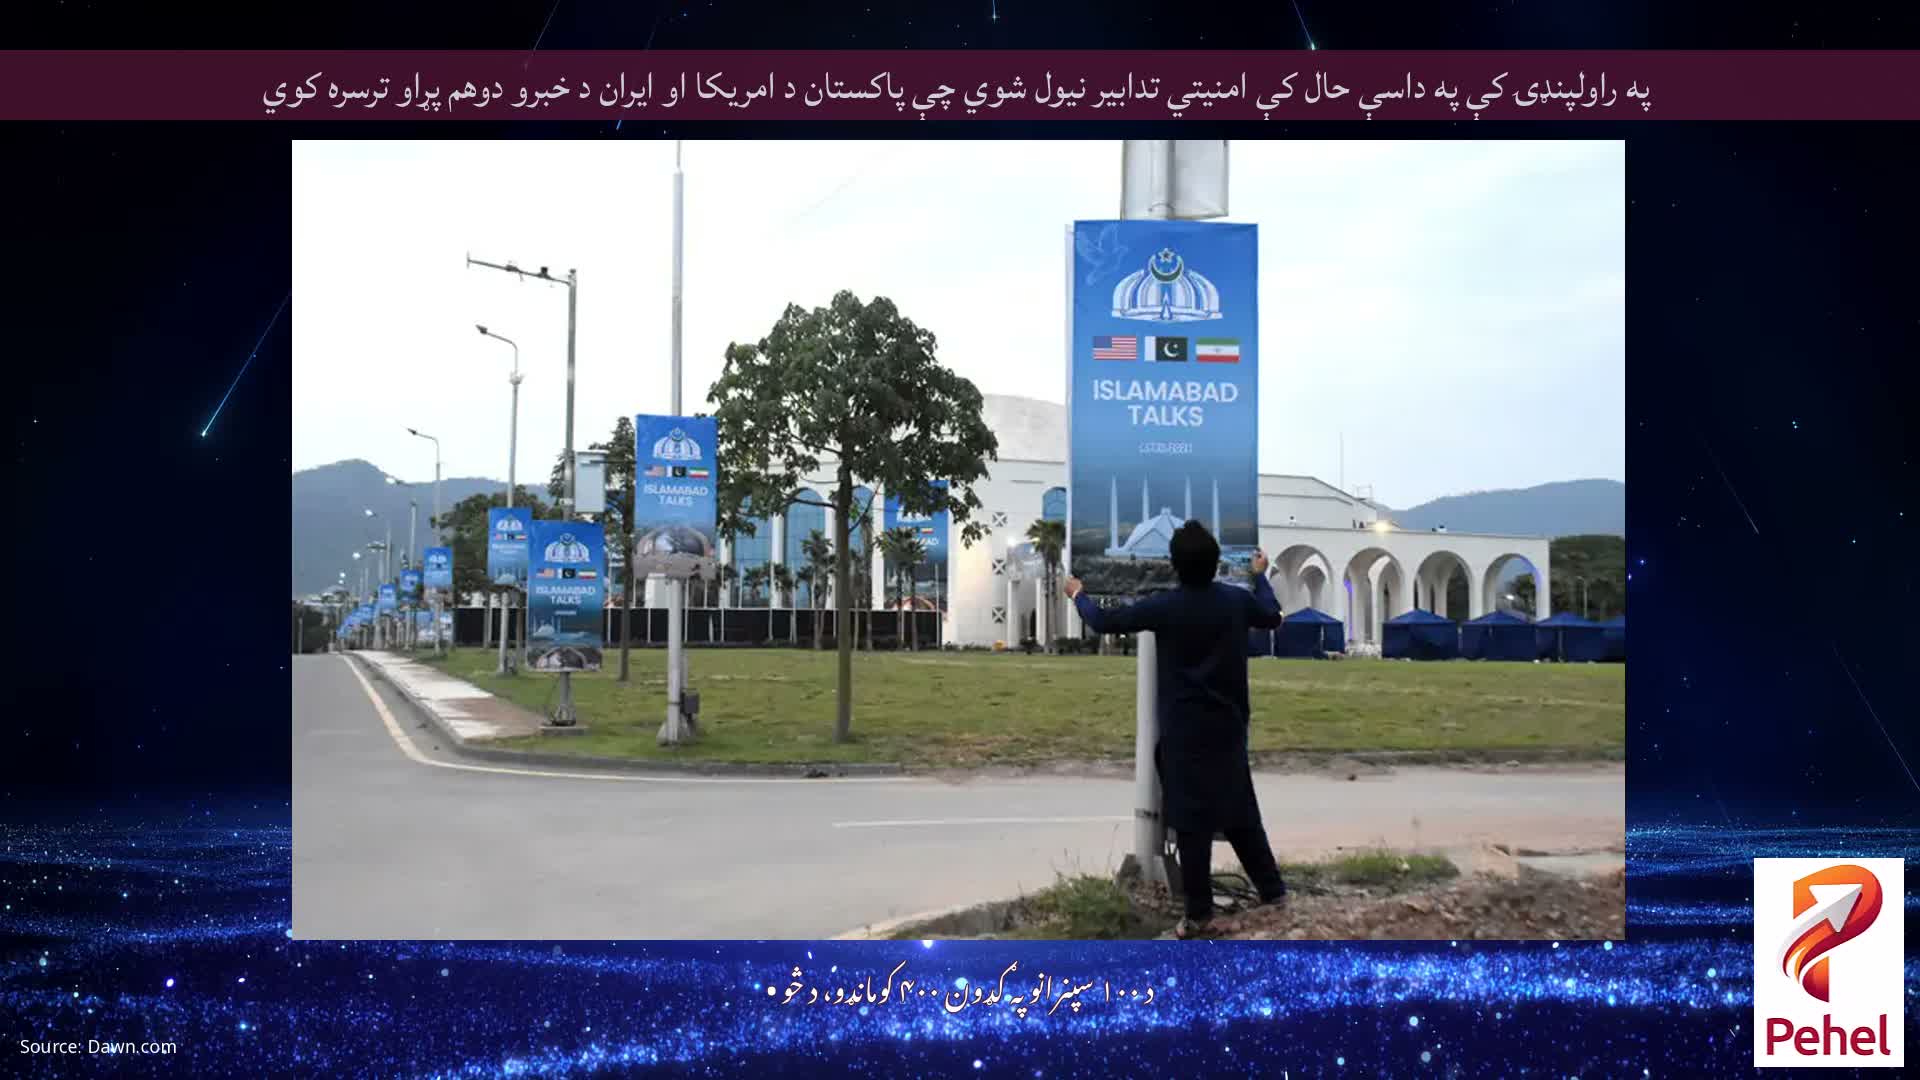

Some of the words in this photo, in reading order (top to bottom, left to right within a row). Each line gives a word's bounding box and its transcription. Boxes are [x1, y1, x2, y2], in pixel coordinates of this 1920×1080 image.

[1092, 379, 1239, 403] ISLAMABAD
[1127, 404, 1204, 427] TALKS
[643, 484, 709, 496] ISLAMABAD
[657, 495, 694, 506] TALKS
[535, 585, 596, 596] ISLAMABAD
[550, 595, 582, 606] TALKS
